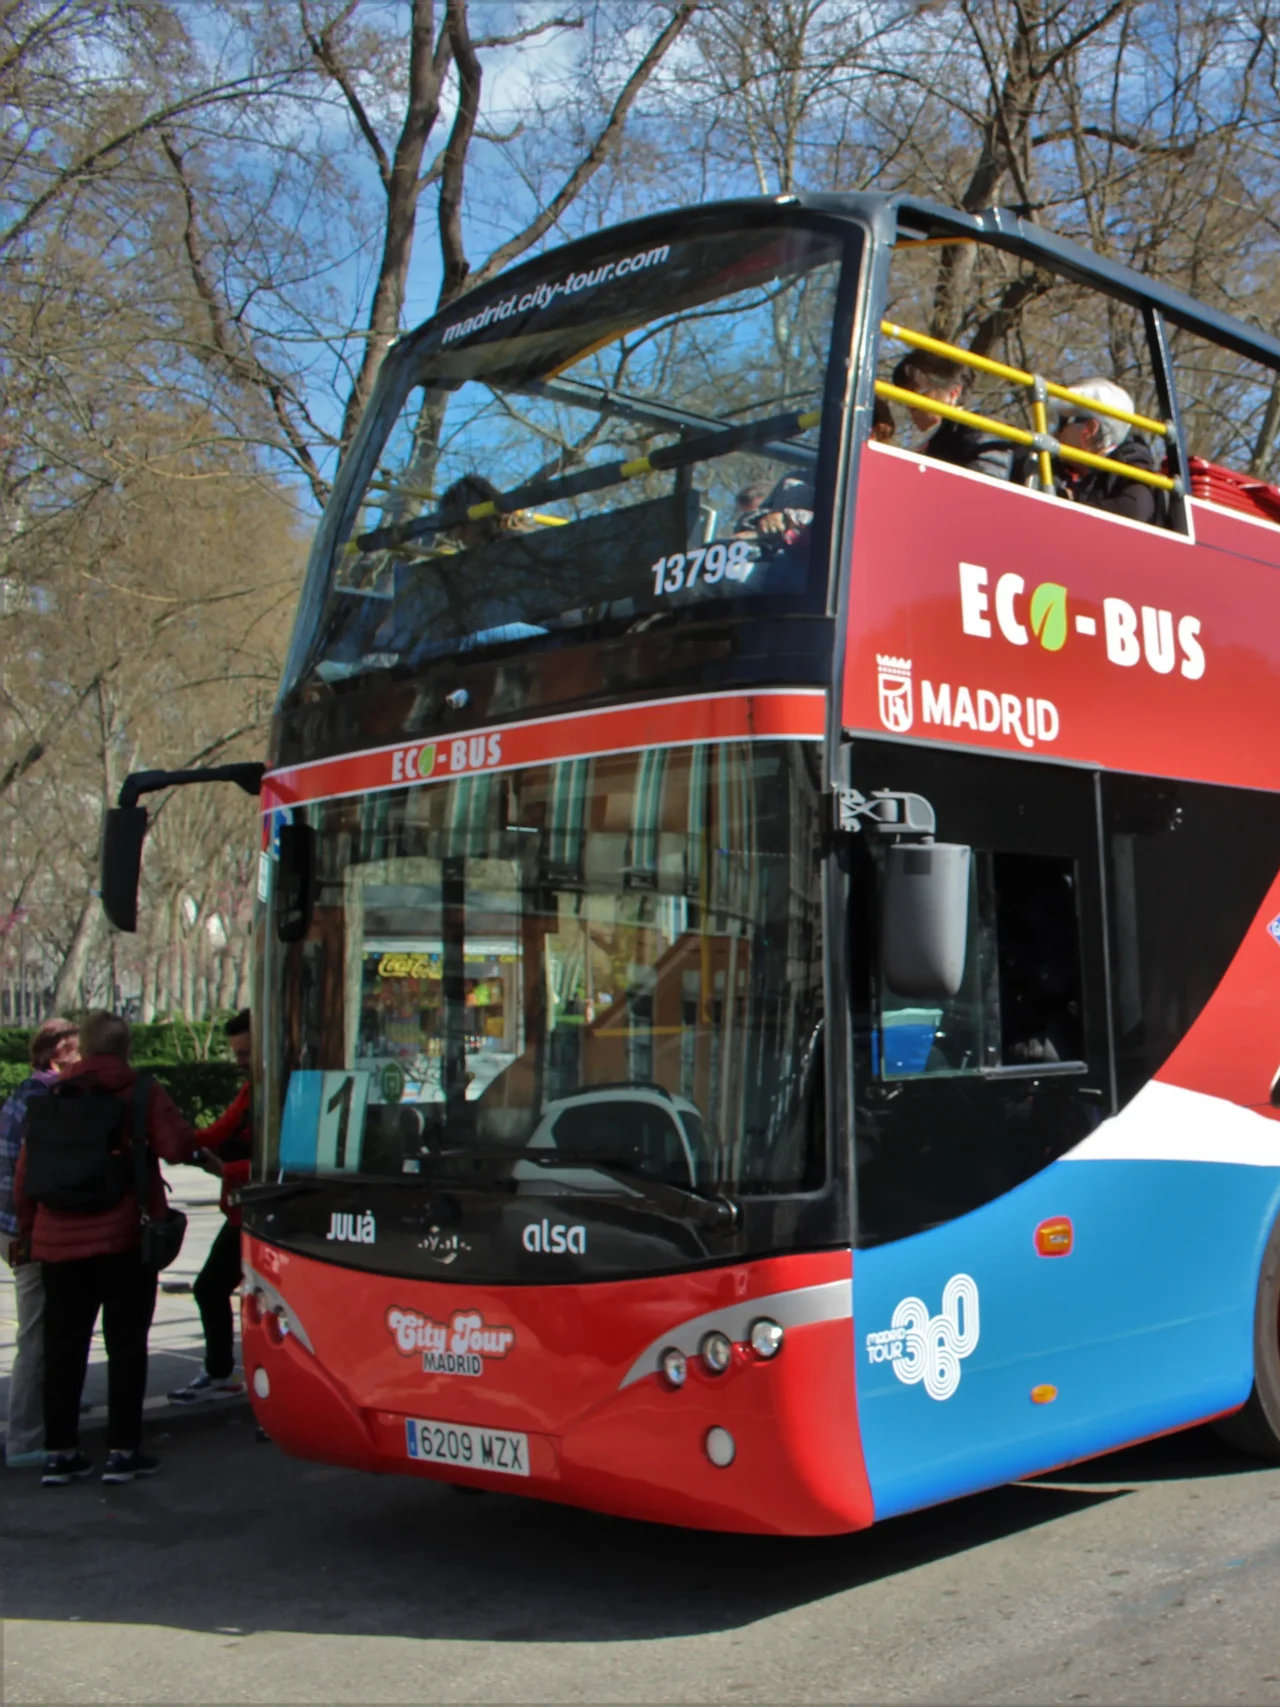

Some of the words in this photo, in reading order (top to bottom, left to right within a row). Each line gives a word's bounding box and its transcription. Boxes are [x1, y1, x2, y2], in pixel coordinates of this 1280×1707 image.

[441, 242, 671, 347] madrid.city-tour.com
[651, 540, 751, 597] 13798
[920, 680, 1060, 748] MADRID
[378, 957, 443, 980] Coca-Co
[326, 1075, 356, 1169] 1
[522, 1218, 587, 1256] alsa
[389, 1311, 447, 1356] City
[451, 1315, 513, 1354] Tour
[866, 1341, 904, 1364] TOUR
[891, 1273, 980, 1401] 360
[423, 1352, 484, 1377] MADRID
[420, 1426, 474, 1462] 6209
[480, 1434, 523, 1470] MZX
